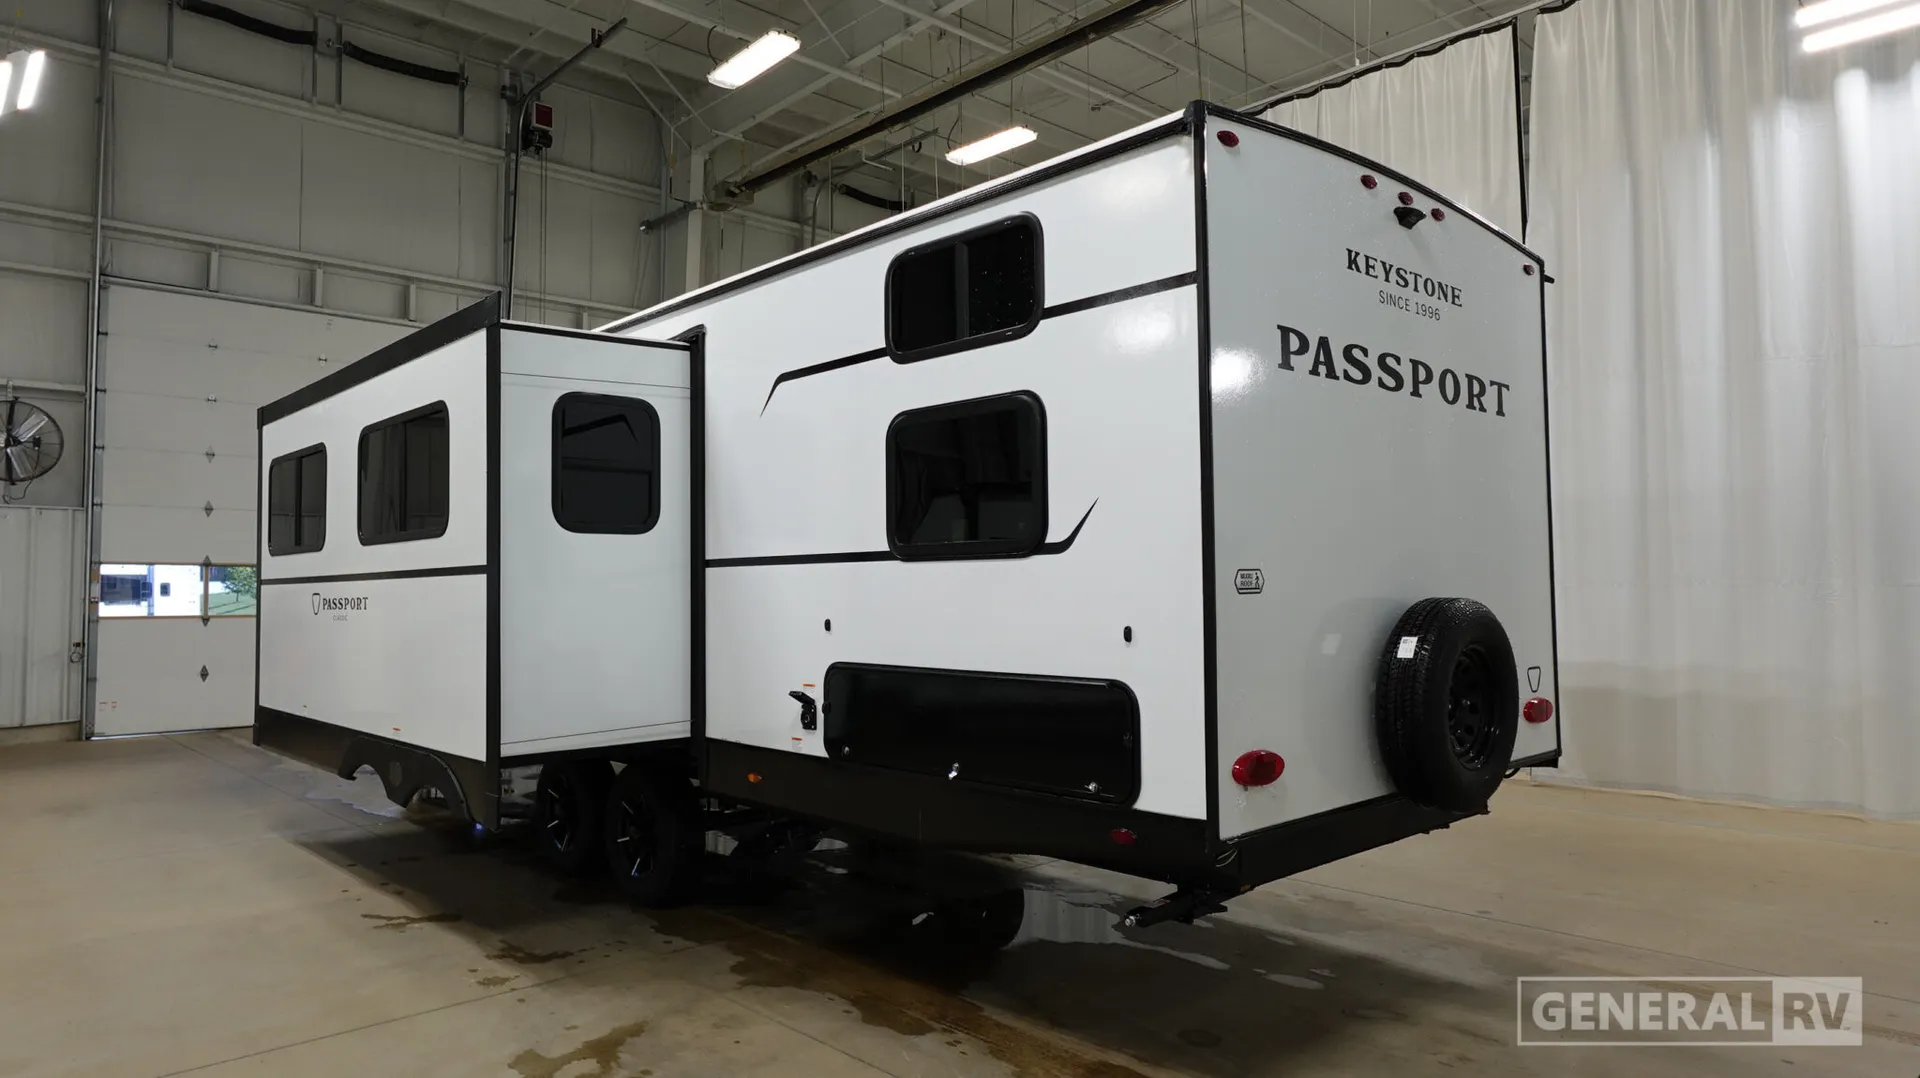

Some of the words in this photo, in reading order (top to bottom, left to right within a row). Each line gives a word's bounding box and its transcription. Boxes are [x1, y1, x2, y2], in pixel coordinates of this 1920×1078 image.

[1346, 248, 1462, 308] KEYSTONE
[1378, 290, 1411, 312] SINCE
[1414, 302, 1441, 321] 1996
[1276, 324, 1510, 417] PASSPORT
[322, 597, 368, 610] PASSPORT
